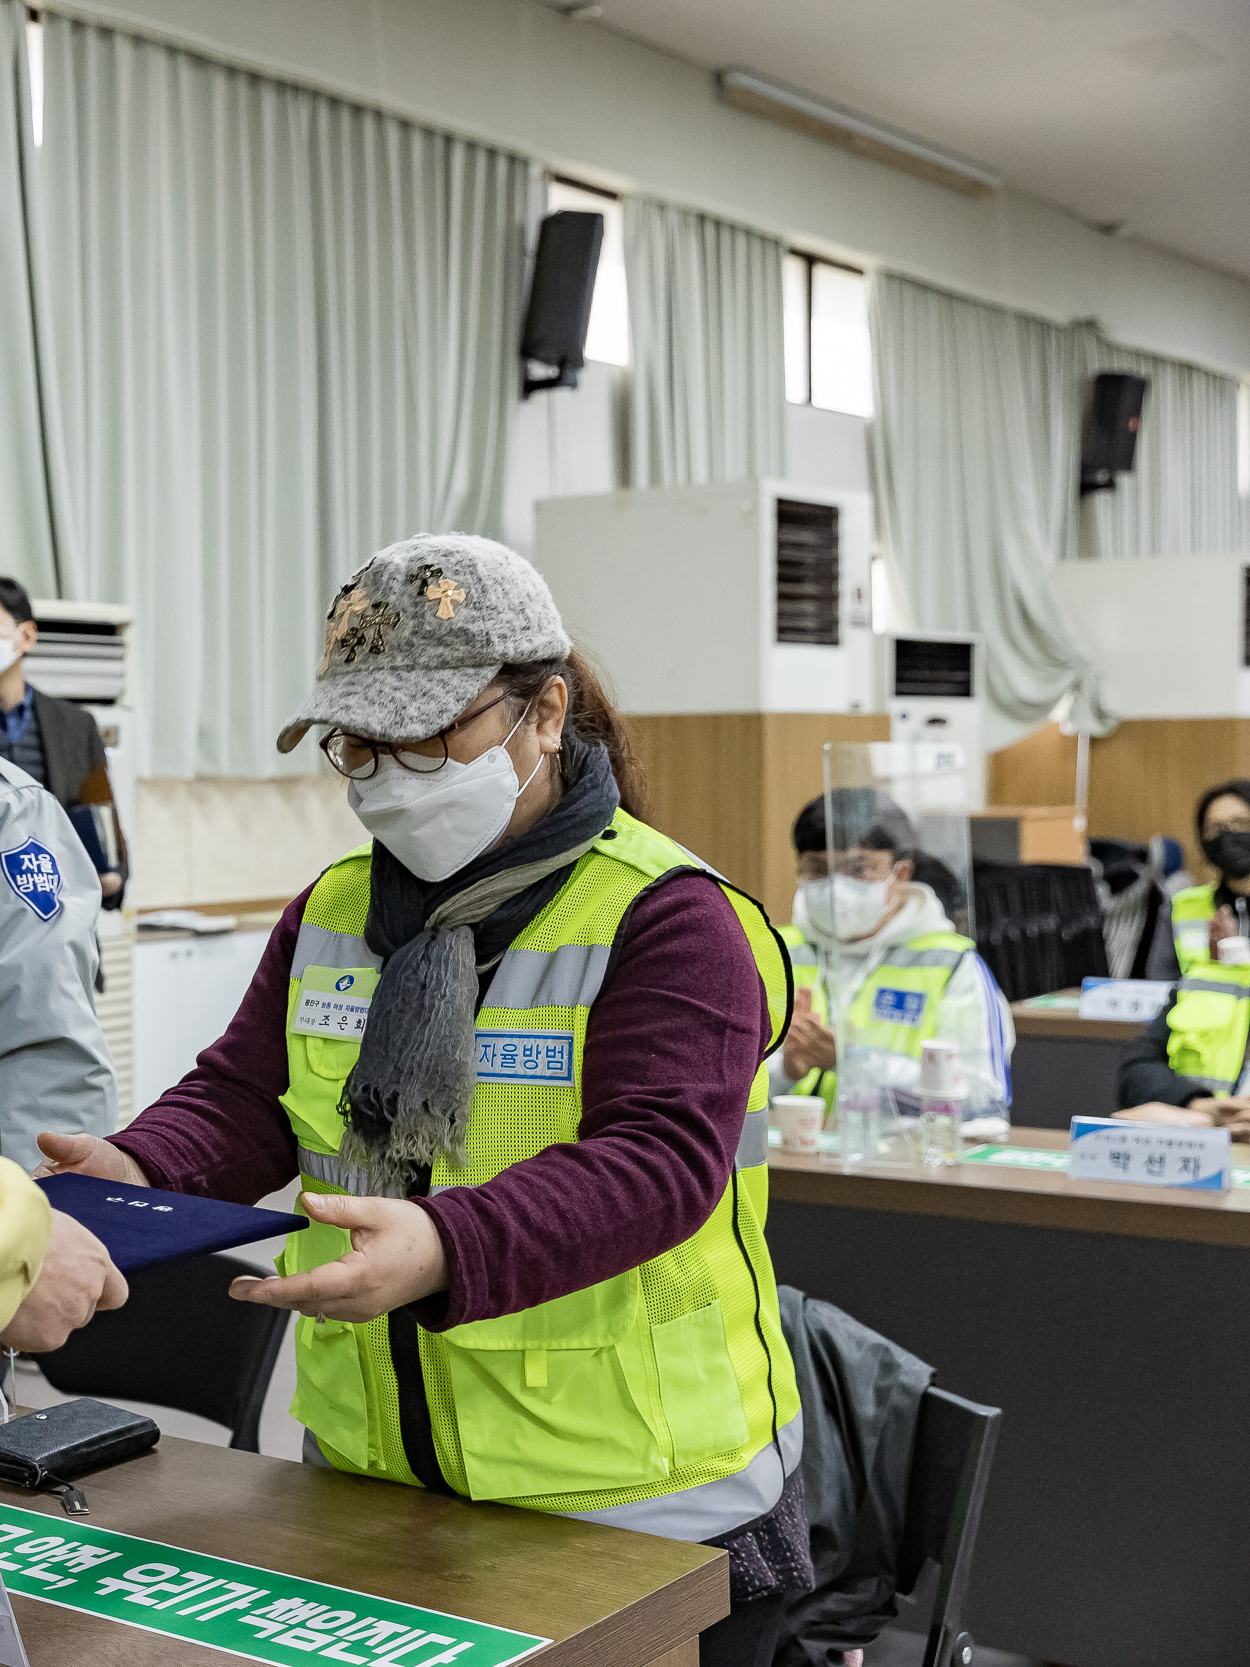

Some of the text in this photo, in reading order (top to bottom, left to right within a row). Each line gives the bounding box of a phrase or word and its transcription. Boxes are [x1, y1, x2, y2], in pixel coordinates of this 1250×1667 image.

[19, 853, 54, 874] 자율
[305, 999, 320, 1007] 광진구
[478, 1042, 565, 1071] 자율방범
